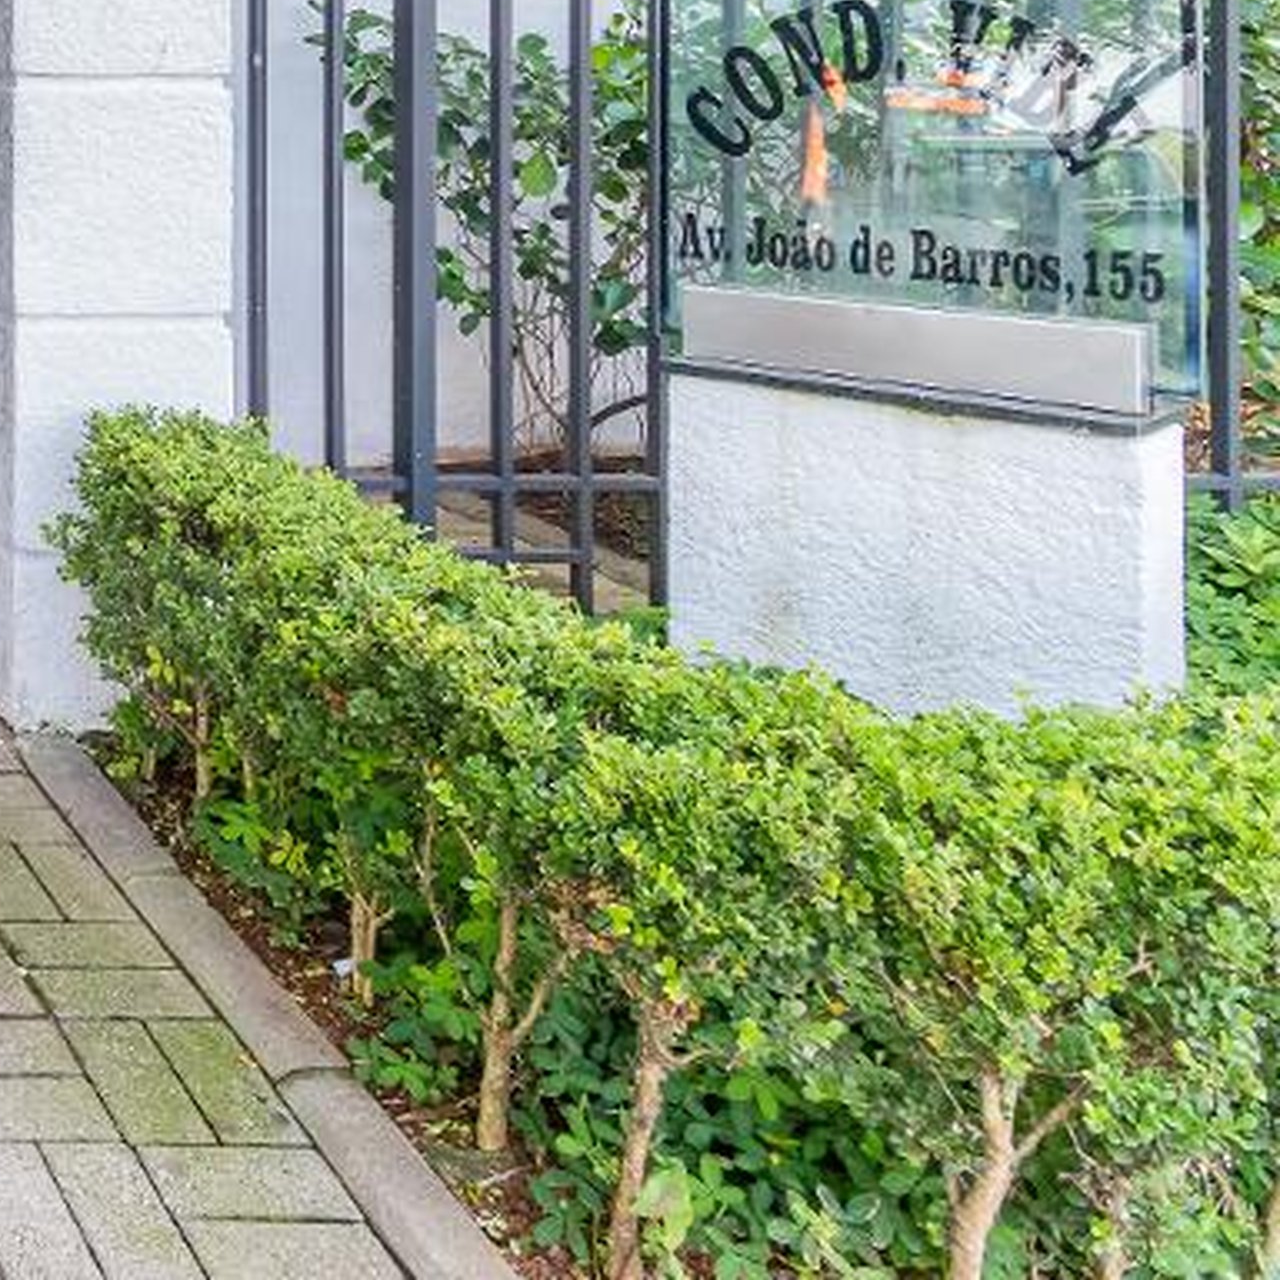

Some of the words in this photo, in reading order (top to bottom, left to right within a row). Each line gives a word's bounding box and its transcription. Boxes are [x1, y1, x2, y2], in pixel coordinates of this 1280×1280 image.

[686, 0, 906, 157] COND.
[679, 212, 733, 262] Av.
[746, 216, 836, 272] João
[850, 224, 896, 277] de
